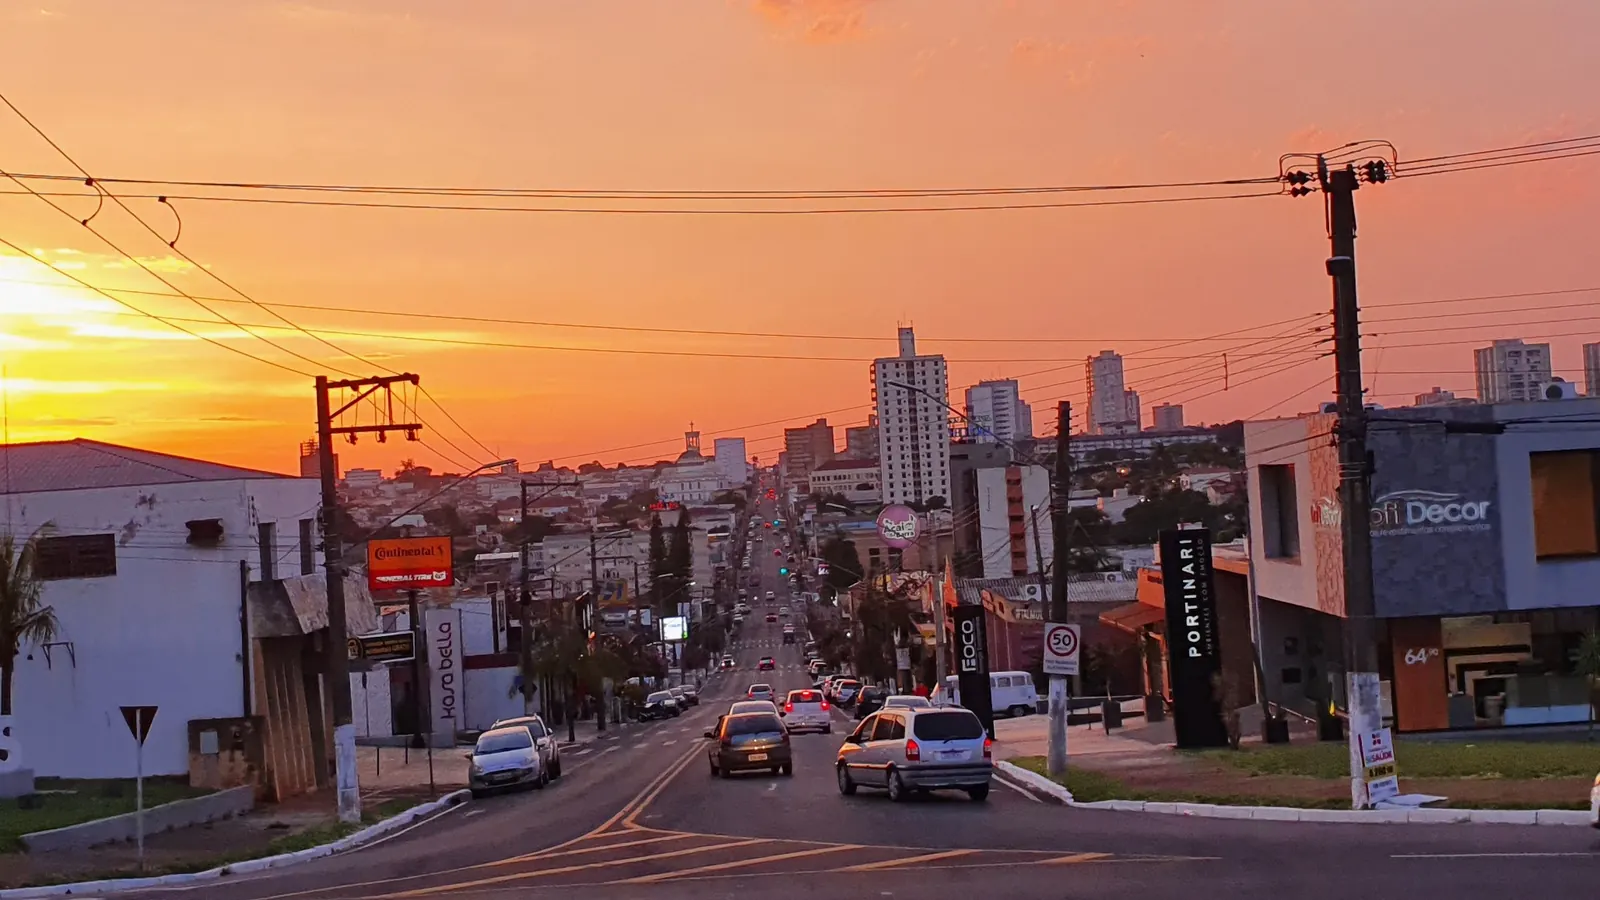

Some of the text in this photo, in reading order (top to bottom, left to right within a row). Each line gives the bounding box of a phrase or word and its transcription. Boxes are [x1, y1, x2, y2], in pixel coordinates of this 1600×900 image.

[1406, 502, 1490, 524] Decor
[375, 546, 434, 560] Continental
[1179, 540, 1201, 657] PORTINARI
[961, 620, 976, 672] FOCO
[1053, 633, 1071, 646] 50
